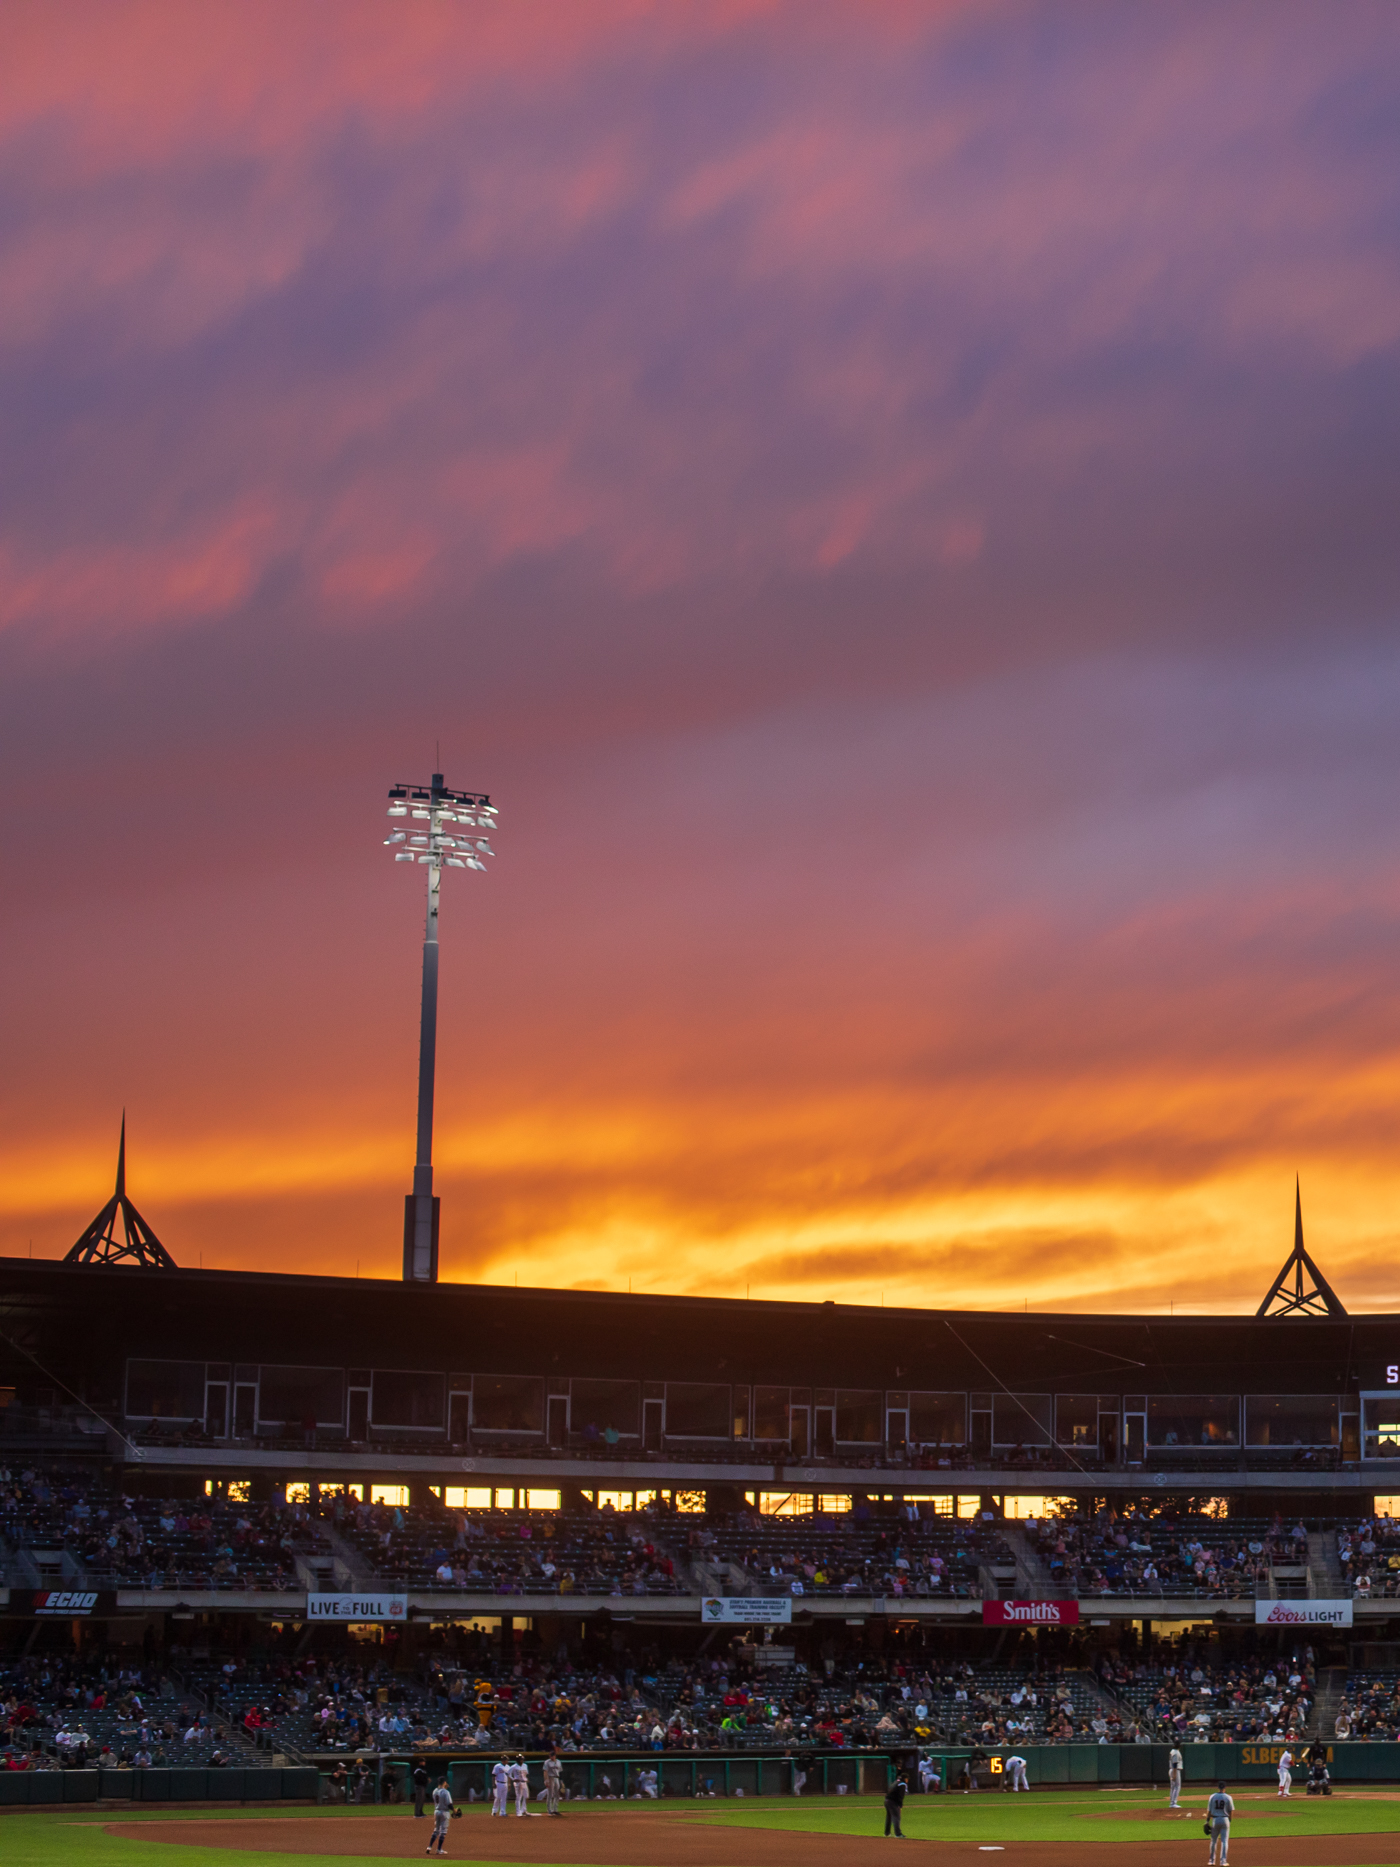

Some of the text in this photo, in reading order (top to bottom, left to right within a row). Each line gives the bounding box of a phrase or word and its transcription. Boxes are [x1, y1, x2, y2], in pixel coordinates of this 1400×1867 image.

[45, 1592, 98, 1607] ECHO
[311, 1602, 339, 1614] LIVE
[353, 1602, 384, 1615] FULL
[1003, 1601, 1060, 1620] Smith's
[1267, 1607, 1343, 1622] Coors LIGHT
[1242, 1747, 1333, 1764] SLBES.CM
[991, 1757, 1002, 1773] 15
[1215, 1800, 1225, 1809] 18
